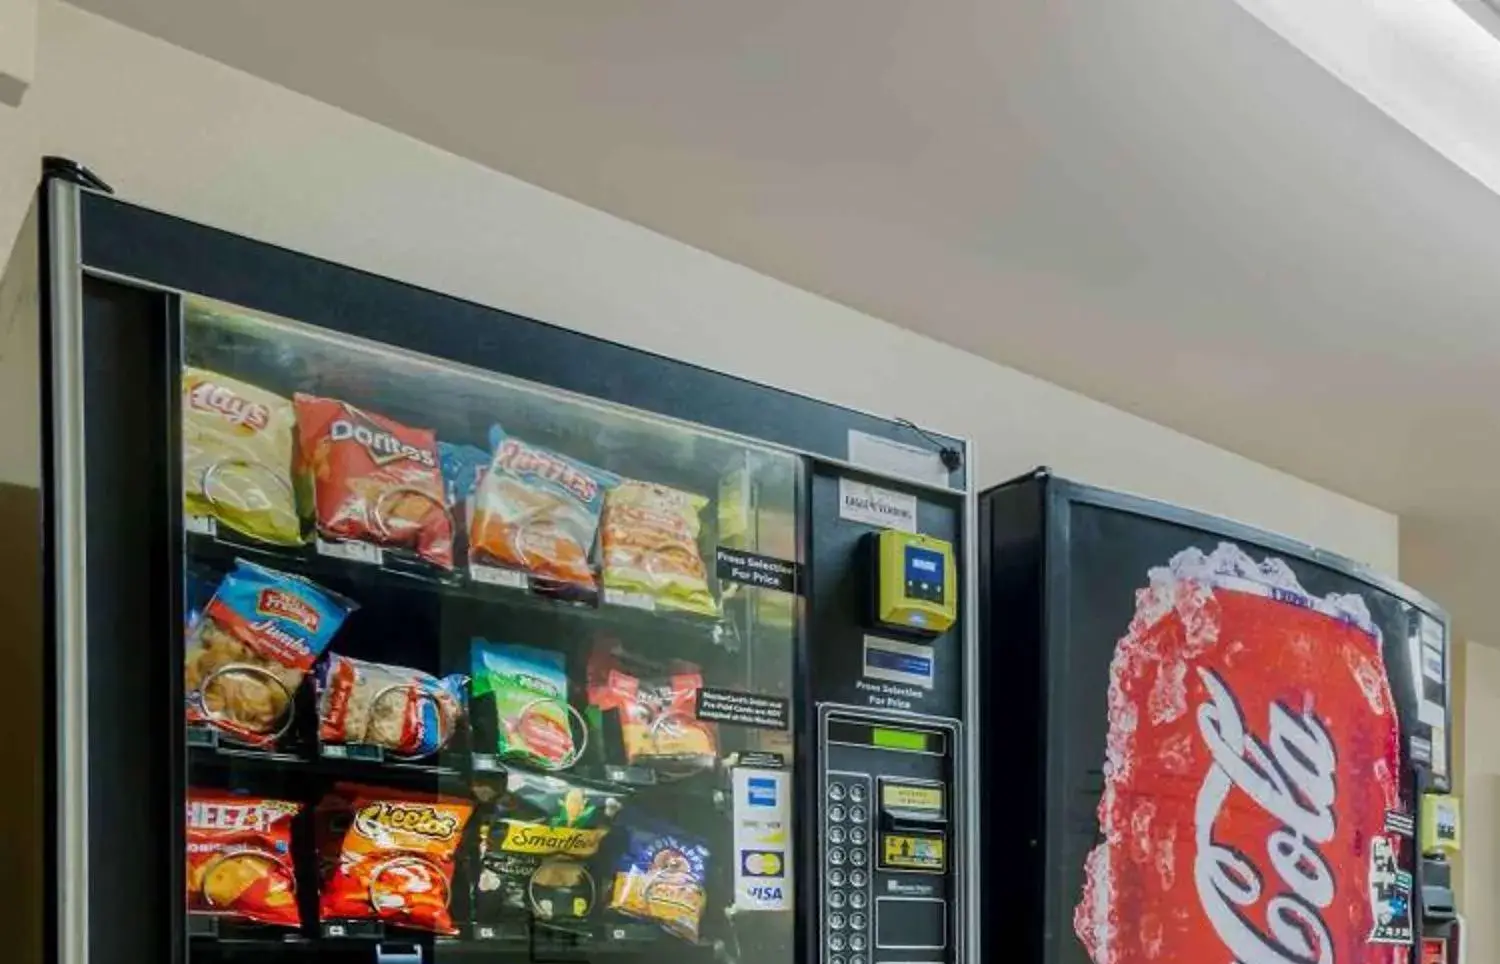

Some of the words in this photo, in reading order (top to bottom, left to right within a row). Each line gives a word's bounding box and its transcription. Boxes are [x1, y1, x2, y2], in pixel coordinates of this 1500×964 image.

[717, 551, 745, 566] Press
[731, 567, 751, 579] For
[753, 571, 780, 586] Price
[856, 680, 880, 693] Press
[869, 695, 885, 705] For
[887, 697, 911, 709] Price
[747, 885, 783, 901] VISA
